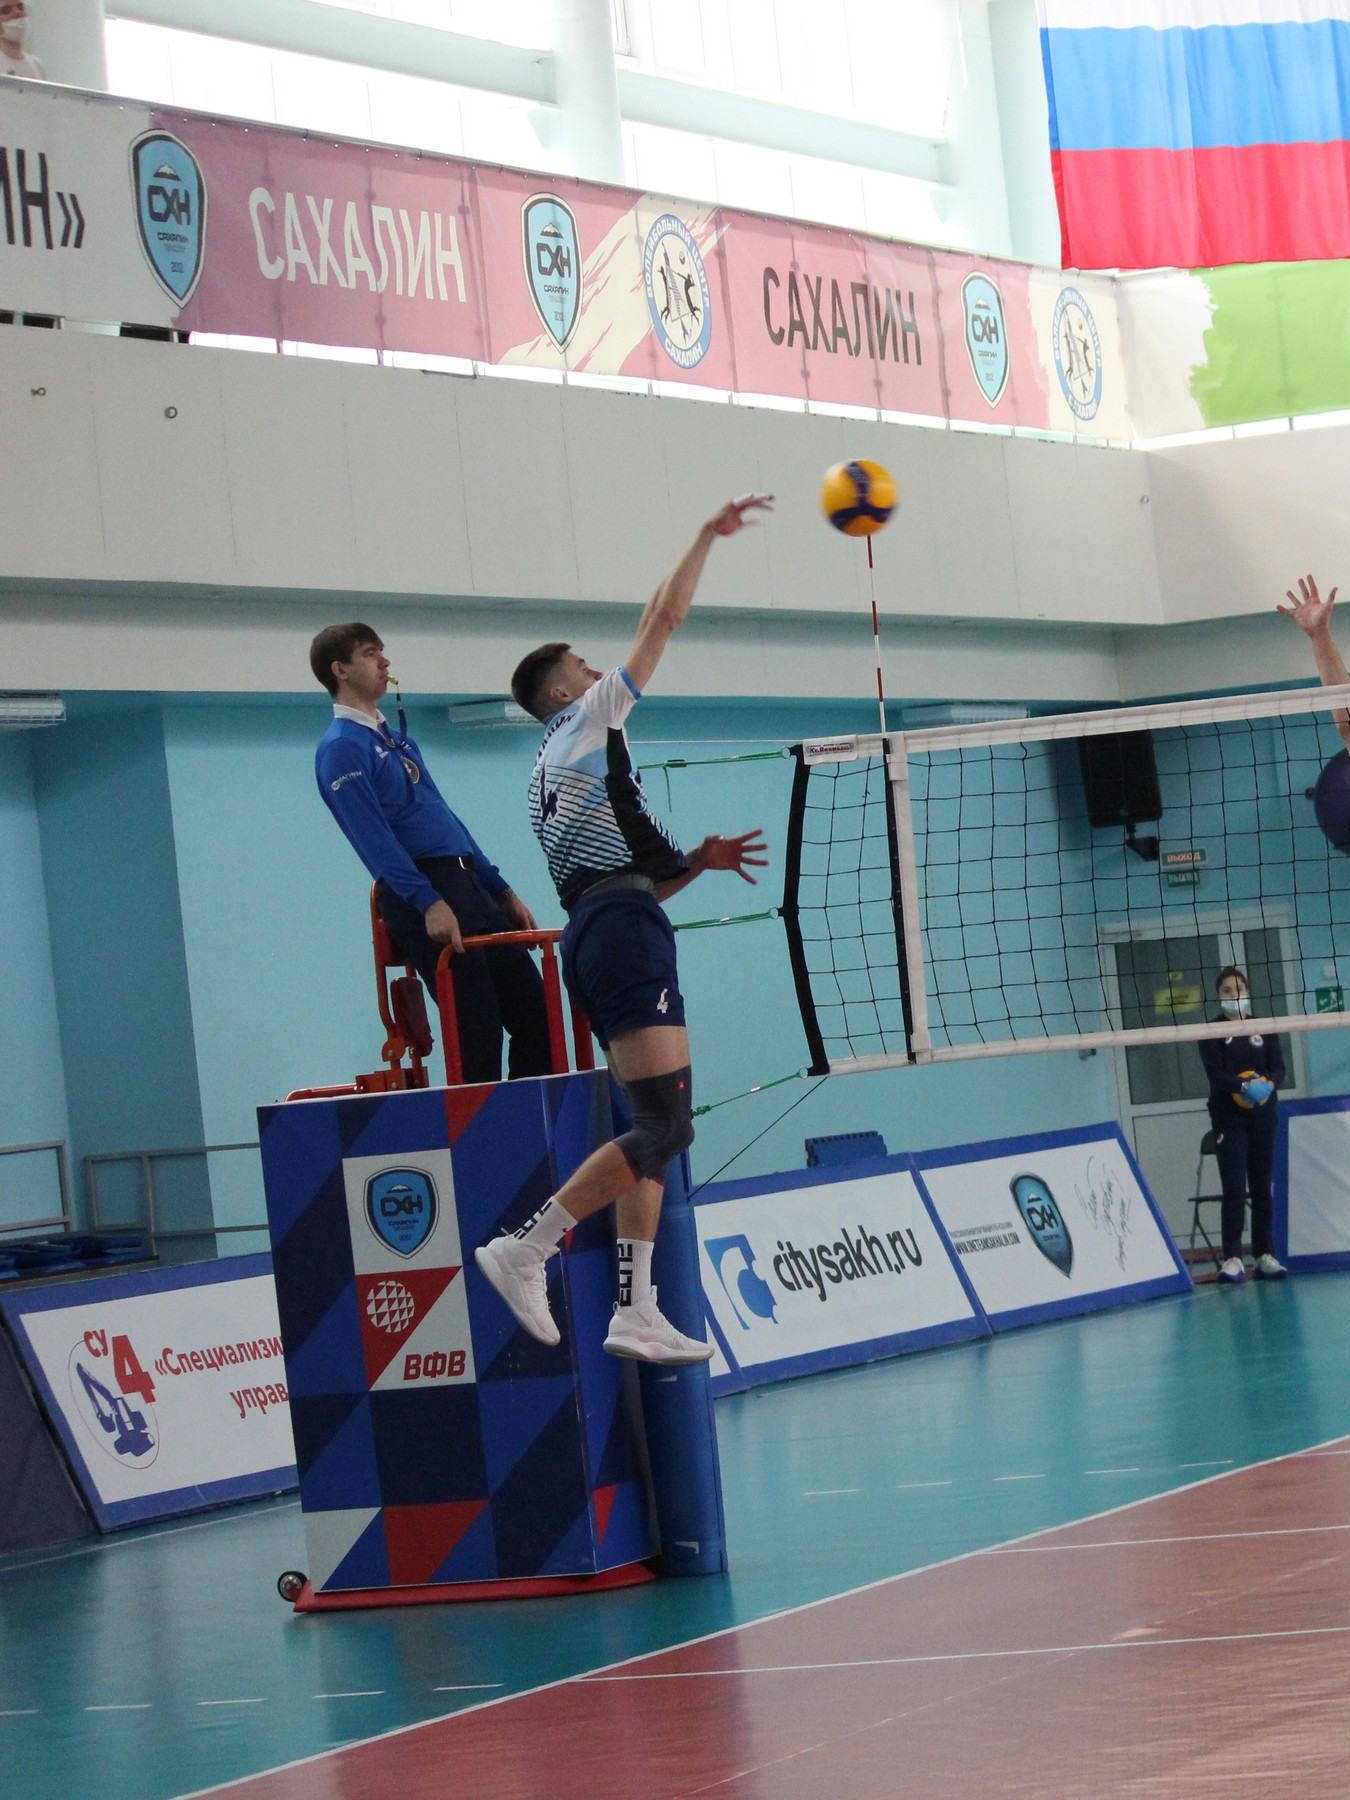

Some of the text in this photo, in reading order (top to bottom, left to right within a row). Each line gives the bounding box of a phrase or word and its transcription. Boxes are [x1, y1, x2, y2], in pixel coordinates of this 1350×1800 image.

[249, 186, 467, 302] САХАЛИН
[762, 265, 923, 367] САХАЛИН
[664, 336, 703, 369] САХАЛИН
[1167, 852, 1201, 863] ВЫХОД
[773, 1225, 922, 1302] citysakh.ru
[403, 1350, 467, 1381] ВФВ
[230, 1382, 290, 1419] управ
